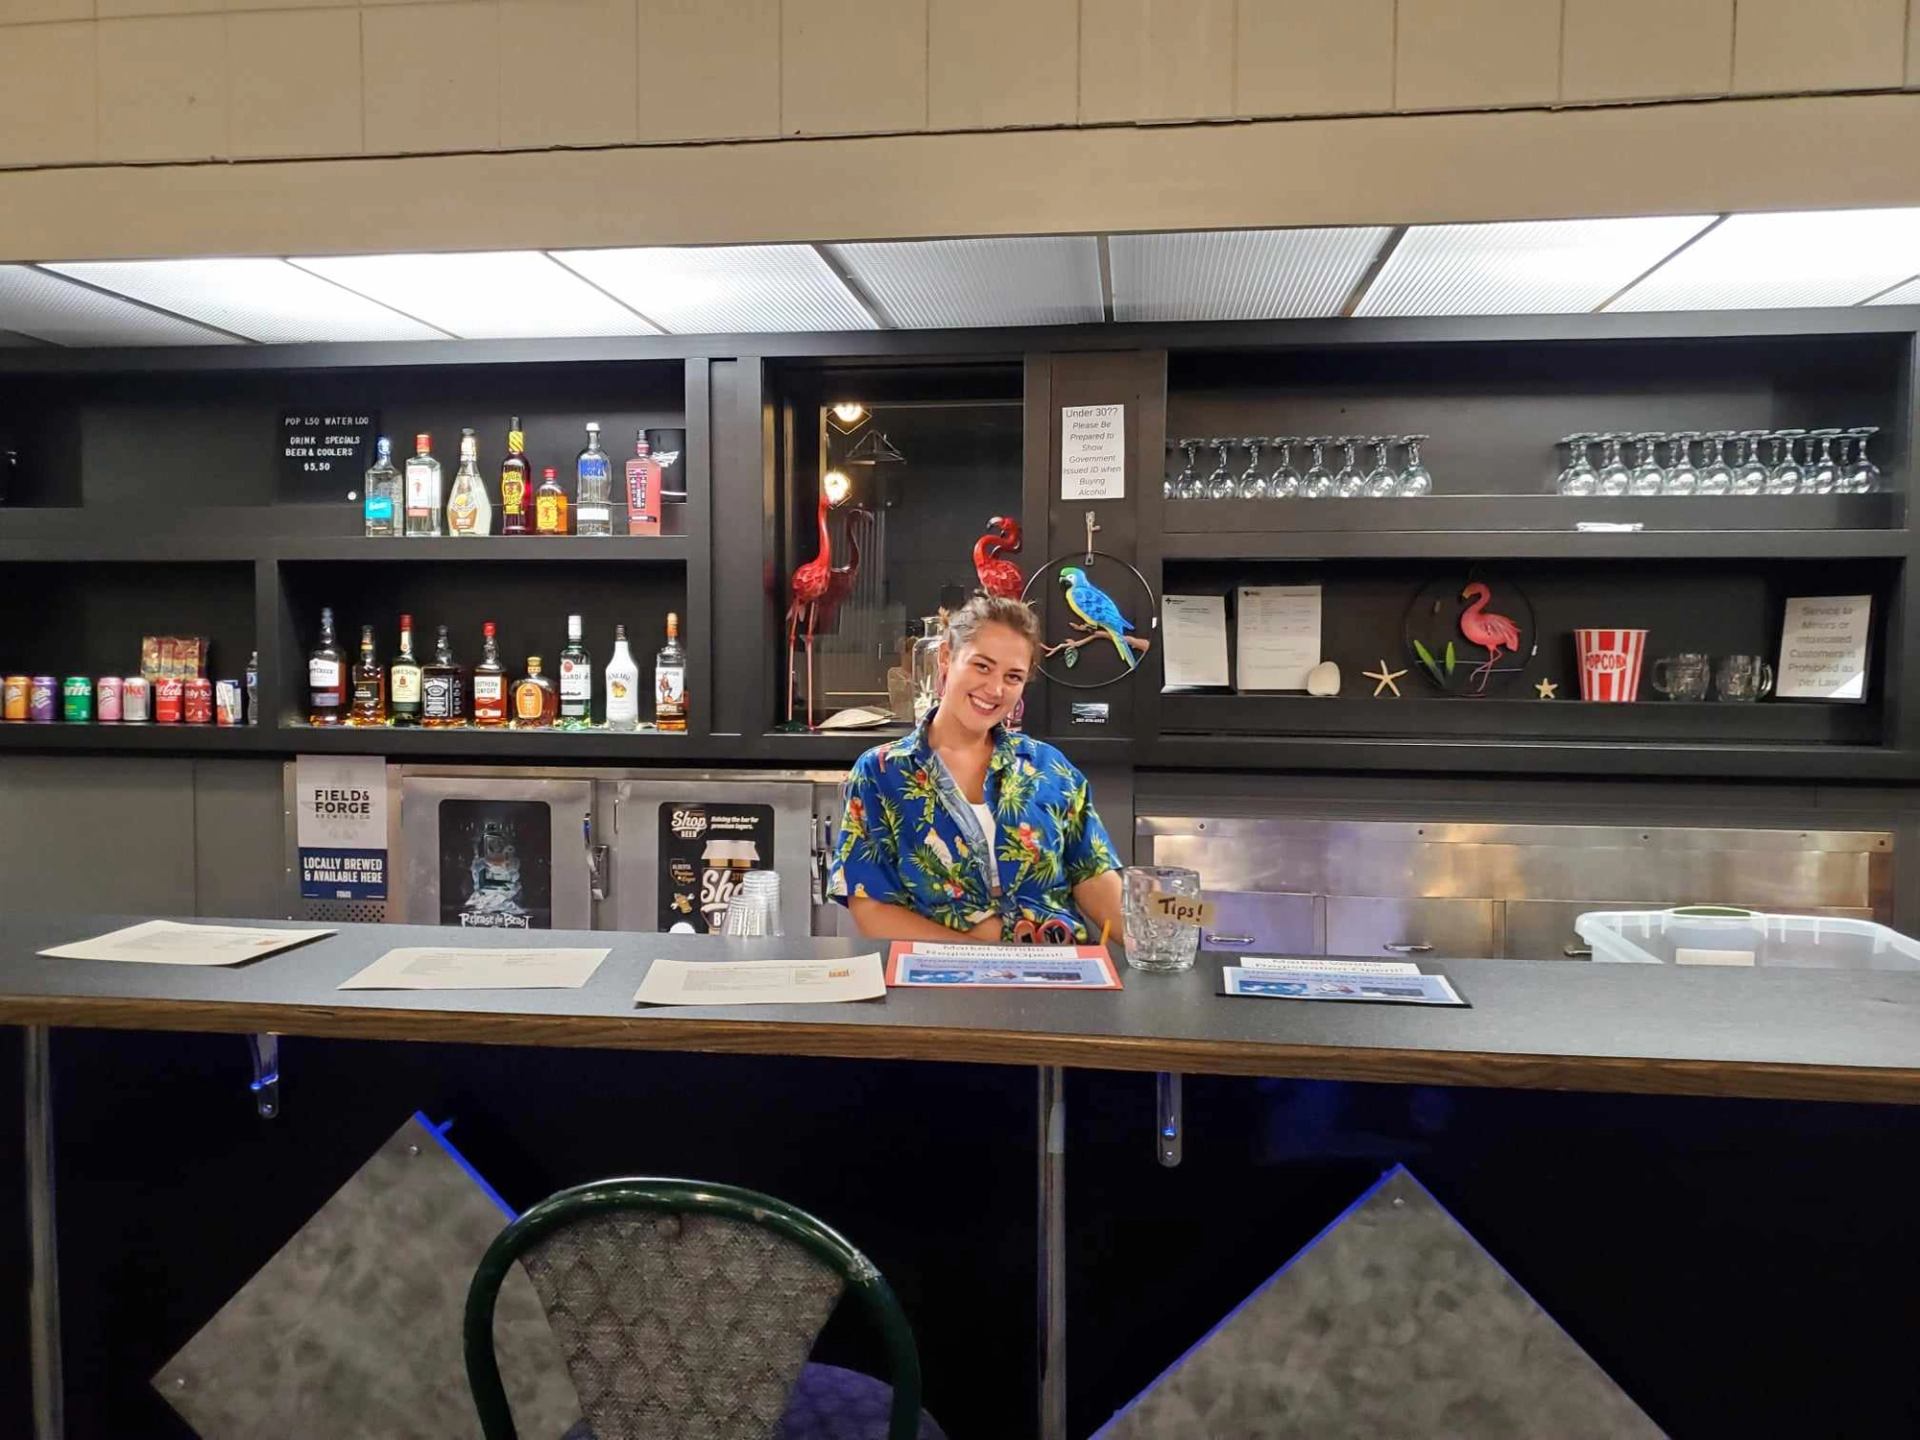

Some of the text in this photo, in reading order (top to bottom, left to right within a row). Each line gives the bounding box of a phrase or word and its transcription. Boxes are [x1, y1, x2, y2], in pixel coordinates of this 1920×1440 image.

[1066, 407, 1118, 418] Under 30??
[285, 417, 301, 426] POP
[324, 417, 353, 425] WATER
[1072, 421, 1111, 429] Please Be
[290, 436, 361, 445] DRINK SPECIALS
[1070, 432, 1115, 441] Prepared to
[317, 448, 353, 456] COOLERS
[1082, 444, 1103, 452] Show
[1069, 455, 1116, 464] Government
[304, 462, 331, 472] $5.50
[1079, 478, 1106, 486] Buying
[1078, 488, 1107, 496] Alcohol
[1801, 607, 1840, 616] Service
[1788, 663, 1840, 673] Prohibited
[315, 802, 371, 814] FORGE
[671, 810, 707, 832] Shop
[304, 857, 383, 871] LOCALLY BREWED
[304, 871, 383, 884] & AVAILABLE HERE
[1158, 897, 1203, 922] Tips!
